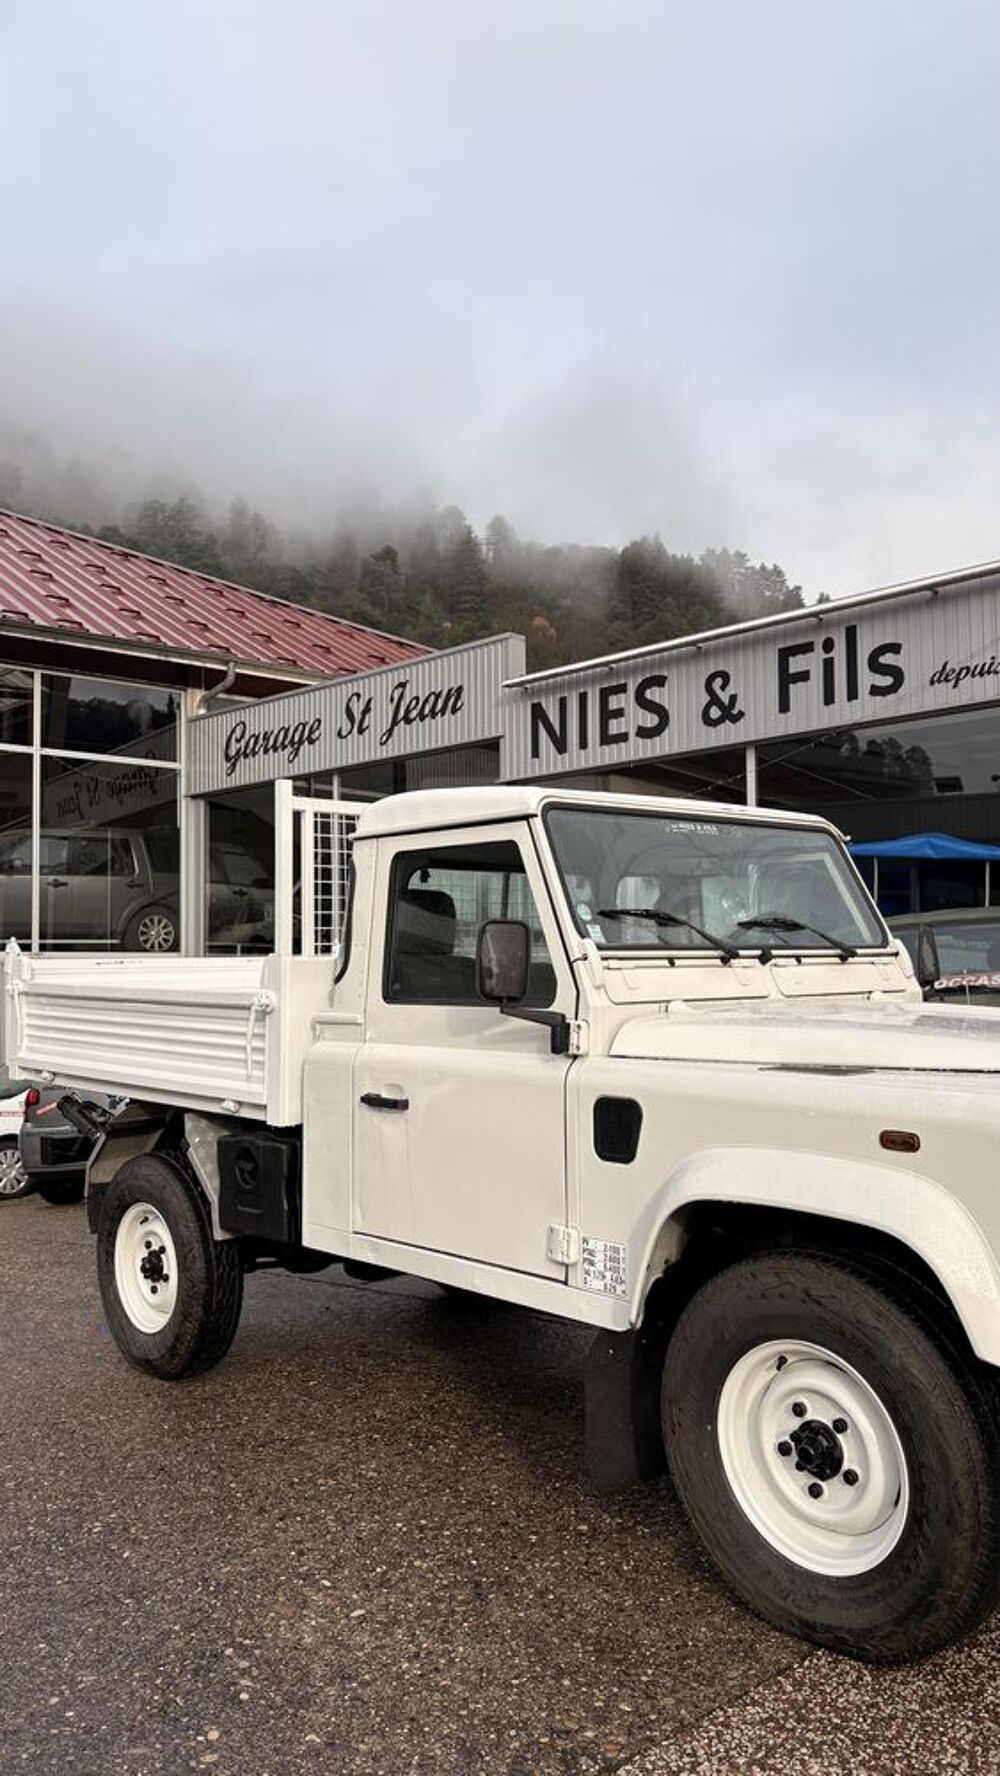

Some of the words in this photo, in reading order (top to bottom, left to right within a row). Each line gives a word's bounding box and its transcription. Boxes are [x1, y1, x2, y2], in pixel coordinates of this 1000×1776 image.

[224, 720, 322, 776] Garage
[337, 691, 373, 739] St
[380, 680, 464, 746] Jean
[530, 674, 670, 759] NIES
[701, 670, 746, 728] &
[777, 625, 904, 714] Fils
